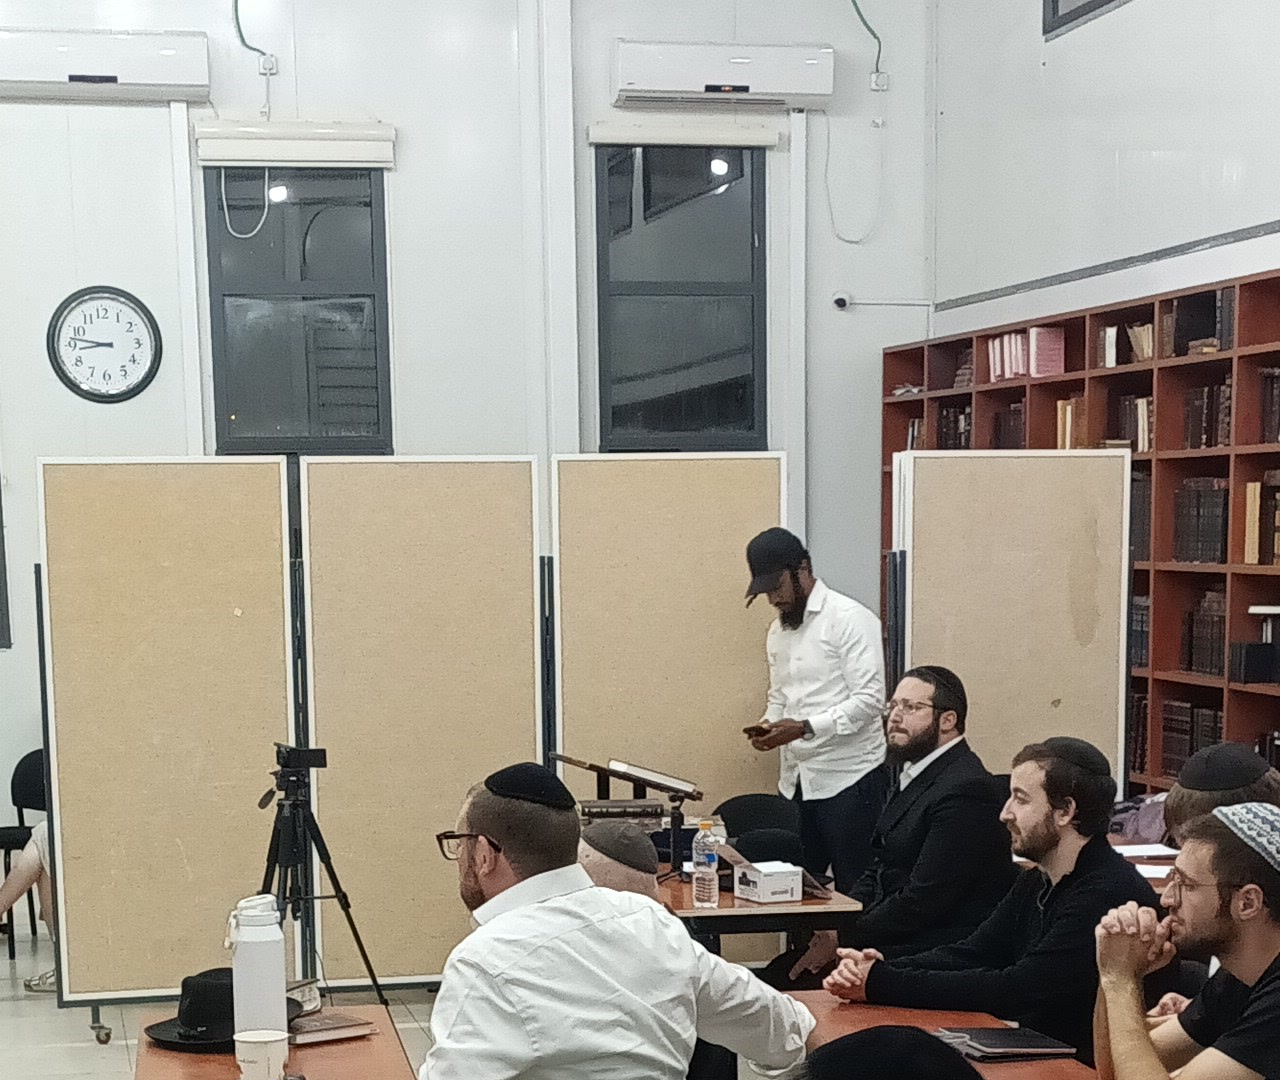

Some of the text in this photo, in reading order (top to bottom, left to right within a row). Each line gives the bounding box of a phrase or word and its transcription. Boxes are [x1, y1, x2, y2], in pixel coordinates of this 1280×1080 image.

[95, 306, 109, 319] 12
[83, 313, 93, 325] 11
[73, 325, 86, 337] 10
[125, 321, 134, 333] 2
[68, 340, 77, 351] 9
[133, 338, 141, 350] 3
[74, 355, 83, 367] 8
[128, 353, 137, 365] 4
[88, 366, 95, 378] 7
[102, 369, 111, 382] 6
[120, 364, 128, 377] 5
